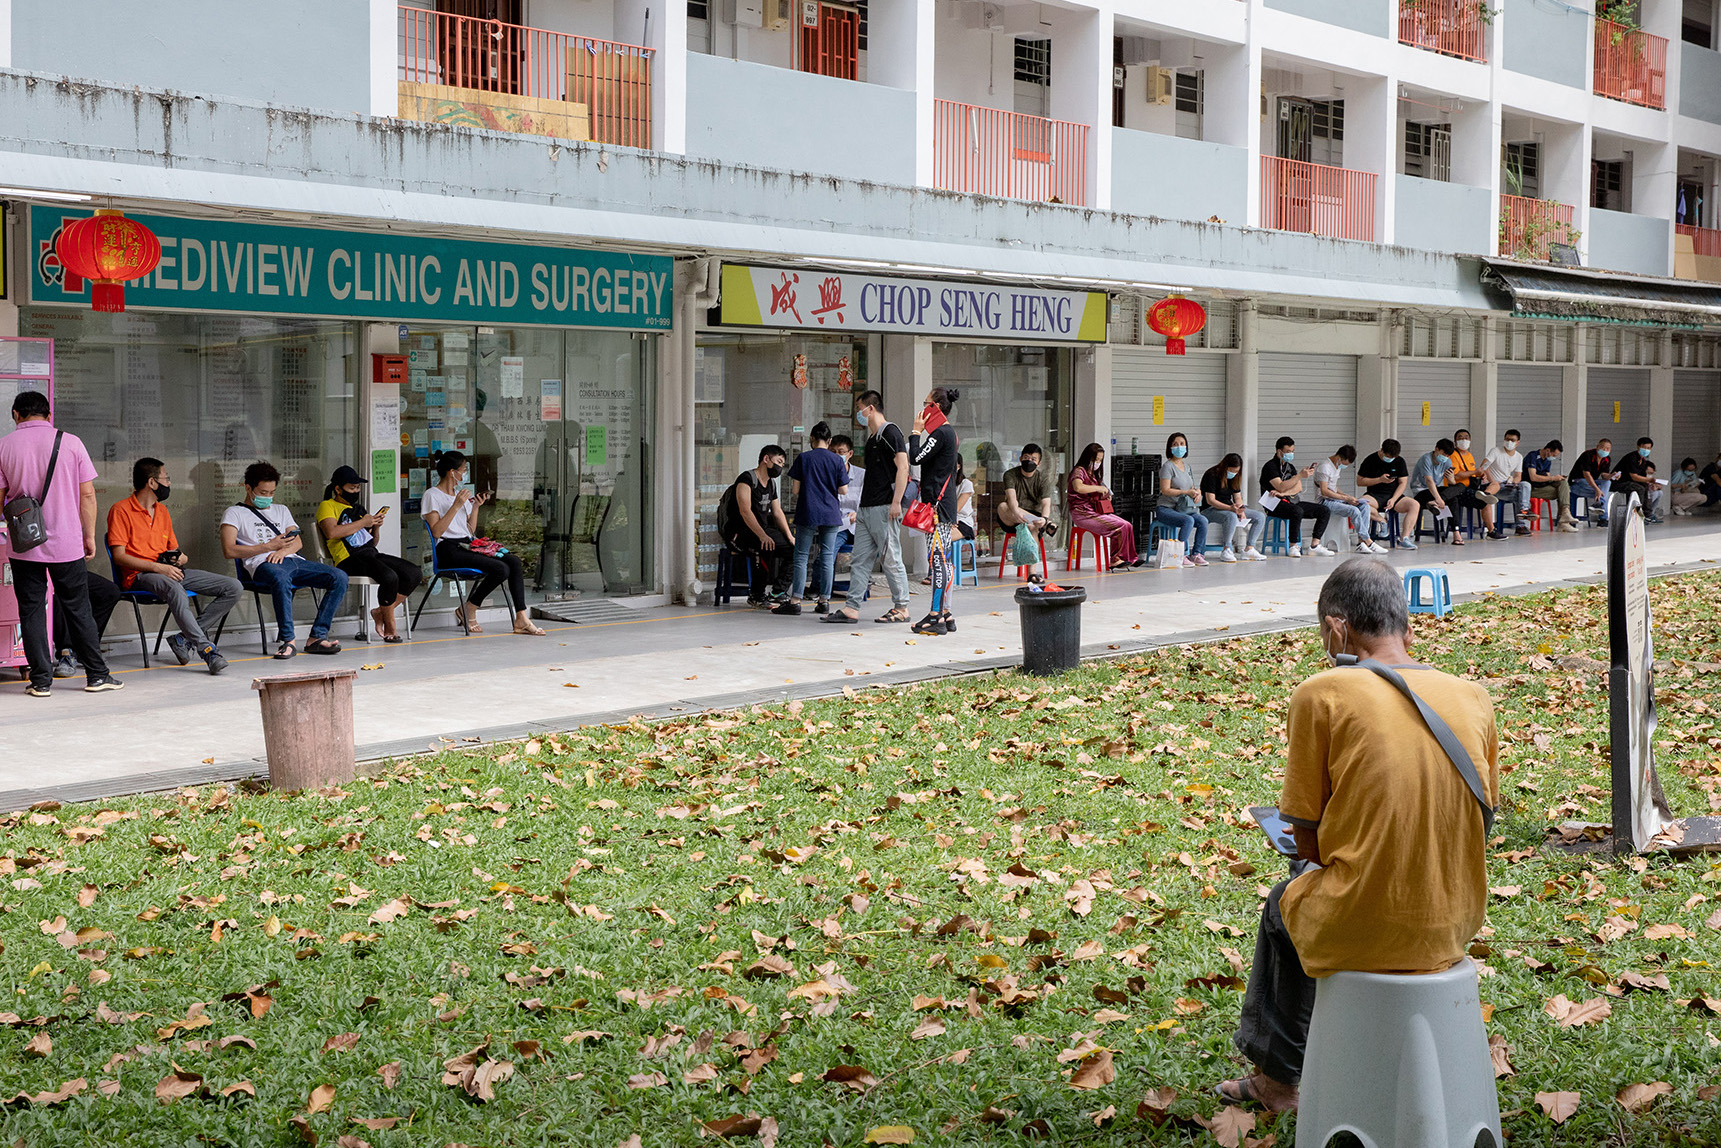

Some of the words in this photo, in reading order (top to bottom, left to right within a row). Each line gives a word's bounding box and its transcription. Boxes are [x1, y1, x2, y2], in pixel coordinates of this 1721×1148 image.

[806, 16, 816, 24] 997
[123, 236, 314, 298] EDIVIEW
[327, 248, 441, 306] CLINIC
[453, 258, 519, 308] AND
[531, 263, 667, 316] SURGERY
[860, 282, 931, 326] CHOP
[939, 289, 1002, 332] SENG
[1010, 294, 1072, 334] HENG
[646, 317, 670, 326] #01-999
[579, 390, 610, 398] CONSULTATION
[611, 390, 626, 398] HOURS
[492, 424, 498, 432] DR
[516, 424, 534, 432] KWONG
